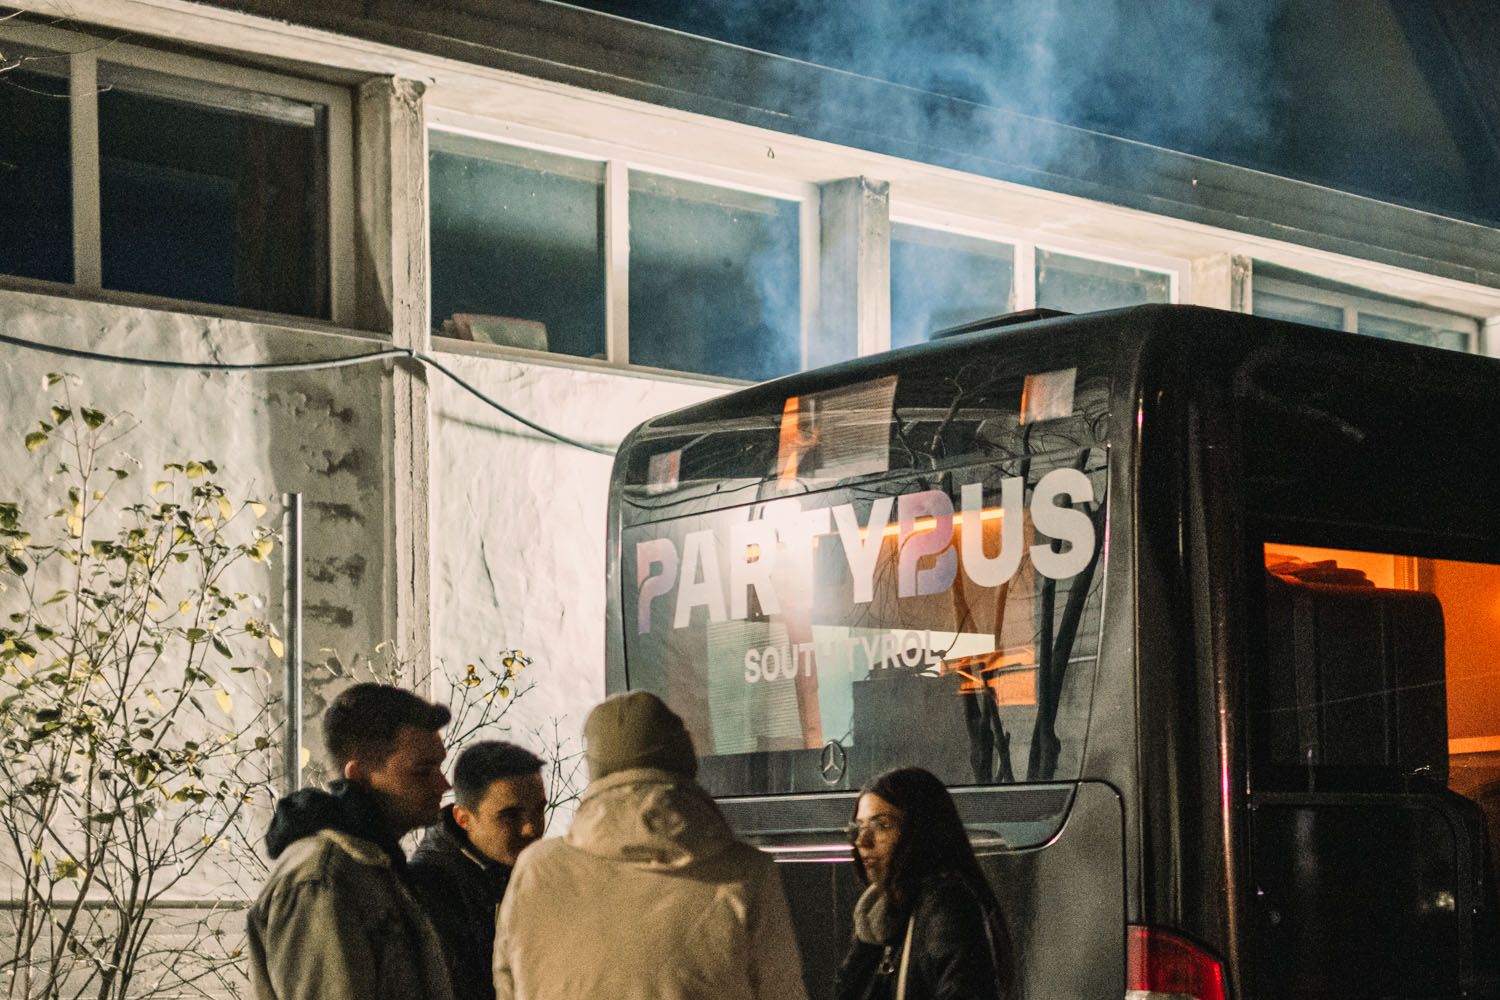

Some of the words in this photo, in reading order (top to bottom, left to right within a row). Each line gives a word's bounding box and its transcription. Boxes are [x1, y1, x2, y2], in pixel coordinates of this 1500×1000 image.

[635, 467, 1096, 635] PARTYBUS
[743, 640, 839, 683] SOUTH
[843, 630, 942, 673] TYROL
